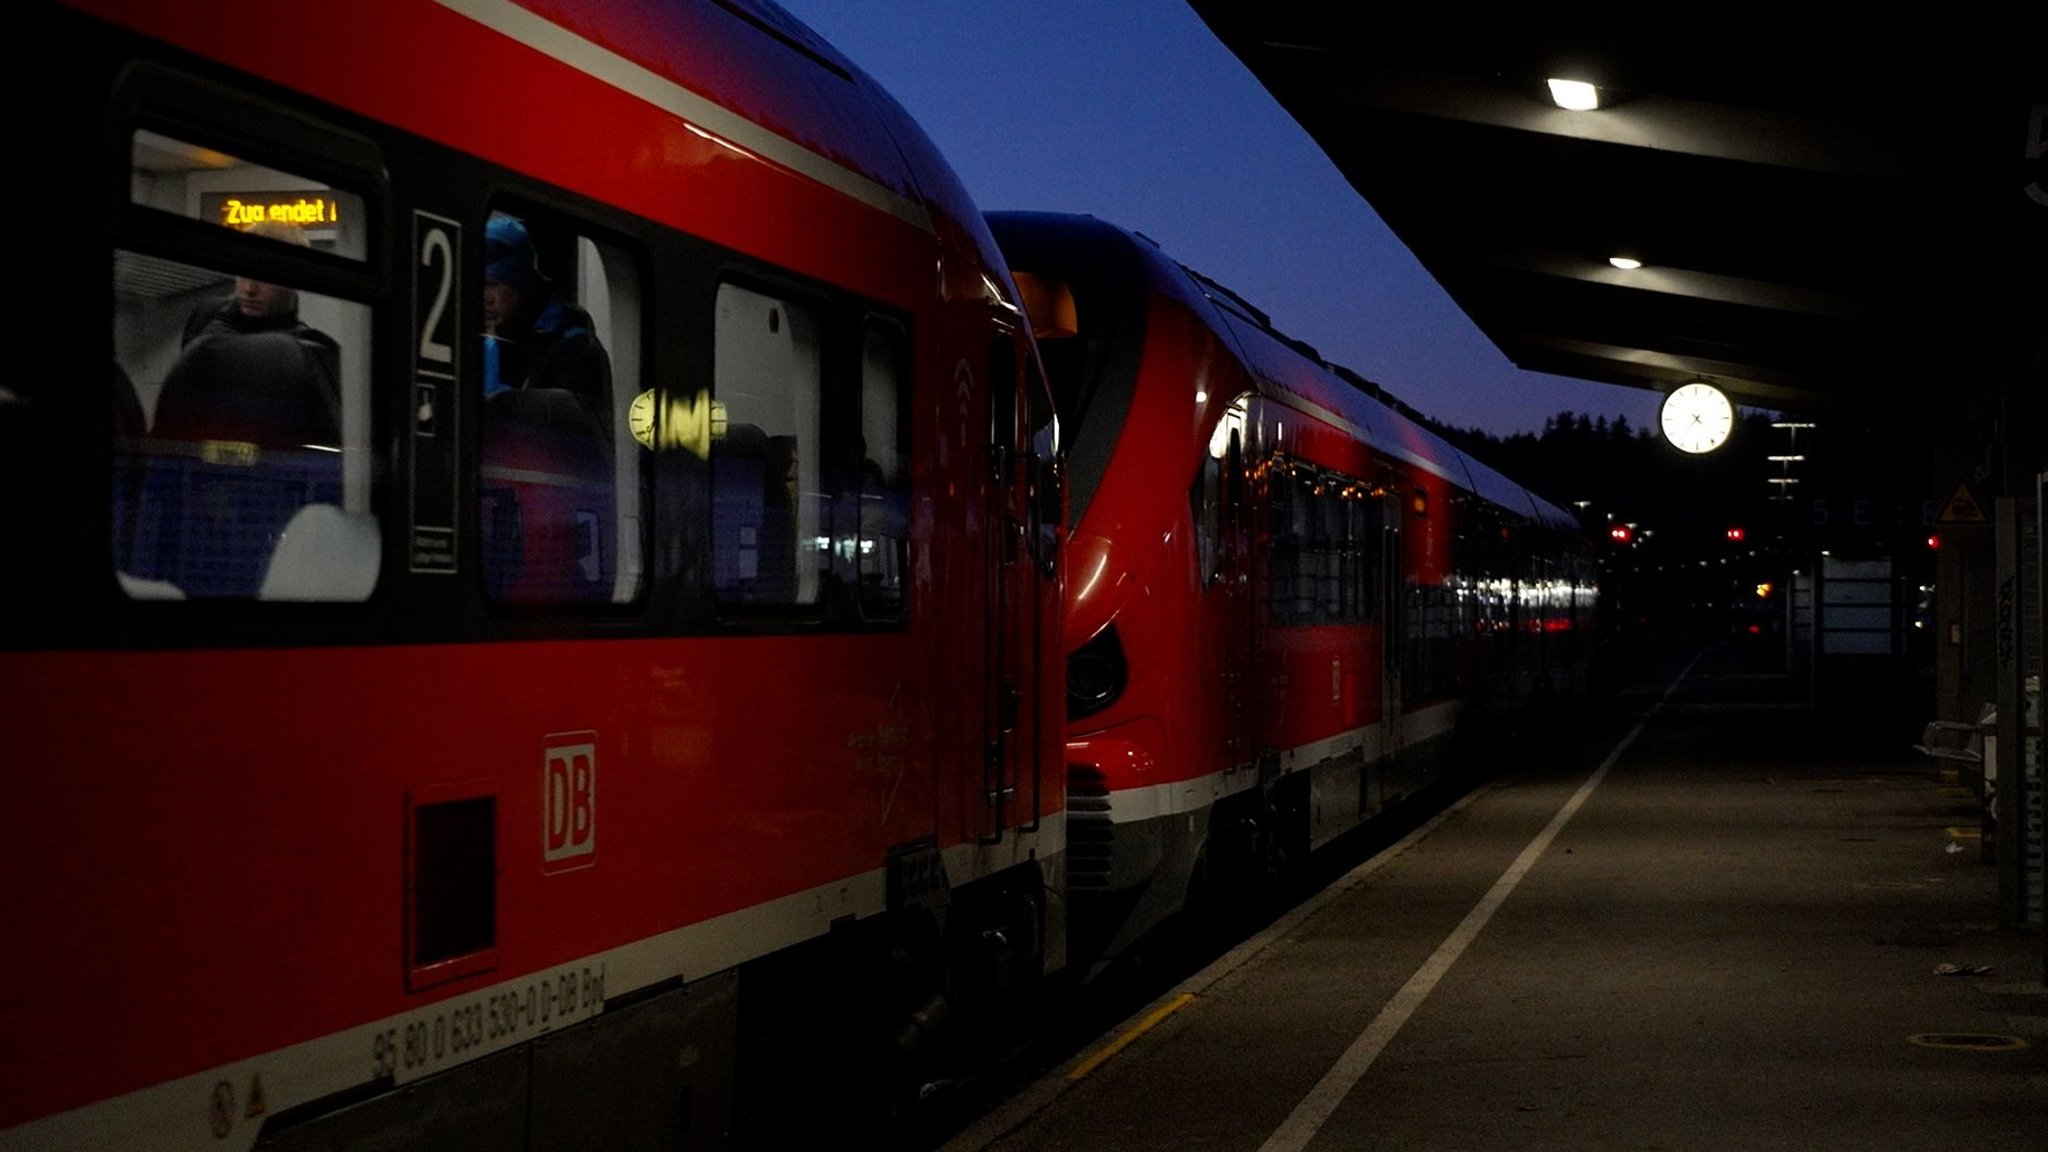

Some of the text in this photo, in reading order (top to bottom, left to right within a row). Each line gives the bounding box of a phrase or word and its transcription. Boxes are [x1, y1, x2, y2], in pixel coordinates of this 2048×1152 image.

[269, 199, 324, 222] endet
[419, 227, 453, 364] 2
[547, 752, 592, 853] DB
[404, 1020, 428, 1069] 80
[434, 1014, 446, 1060] 0
[451, 1002, 483, 1052] 633
[489, 985, 537, 1040] 530-0
